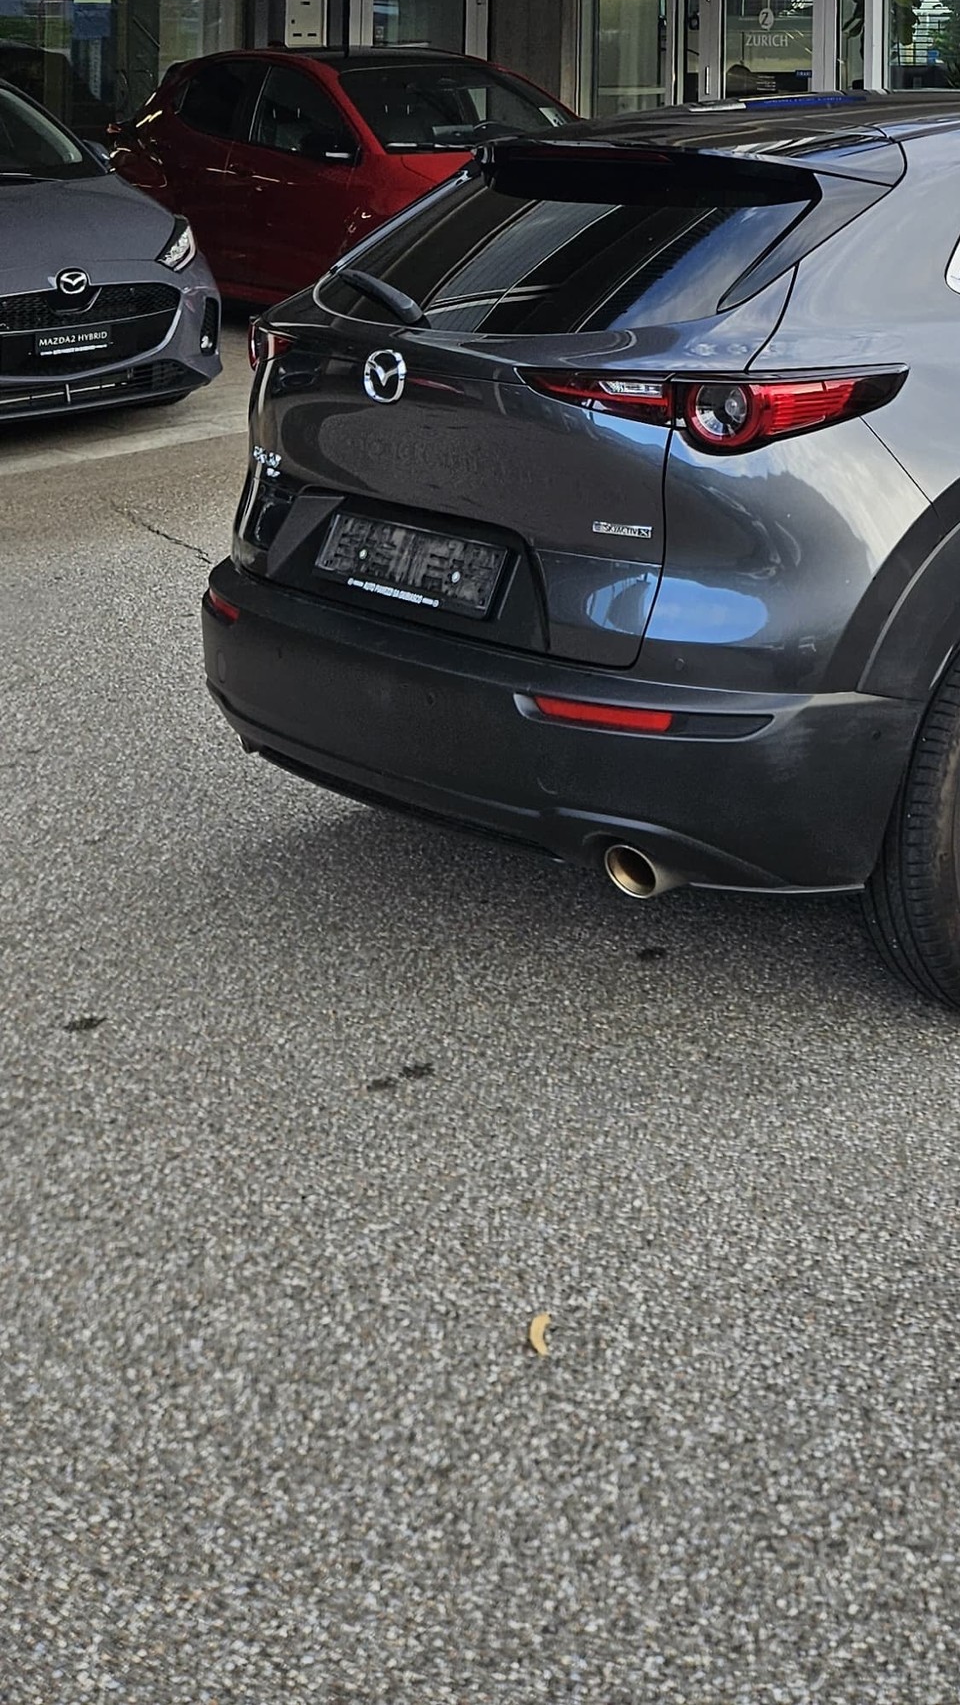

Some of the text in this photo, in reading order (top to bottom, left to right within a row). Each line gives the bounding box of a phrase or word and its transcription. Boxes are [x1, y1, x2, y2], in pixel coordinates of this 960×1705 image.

[745, 34, 789, 47] ZURICH
[39, 331, 108, 347] MAZDA2 HYBRID
